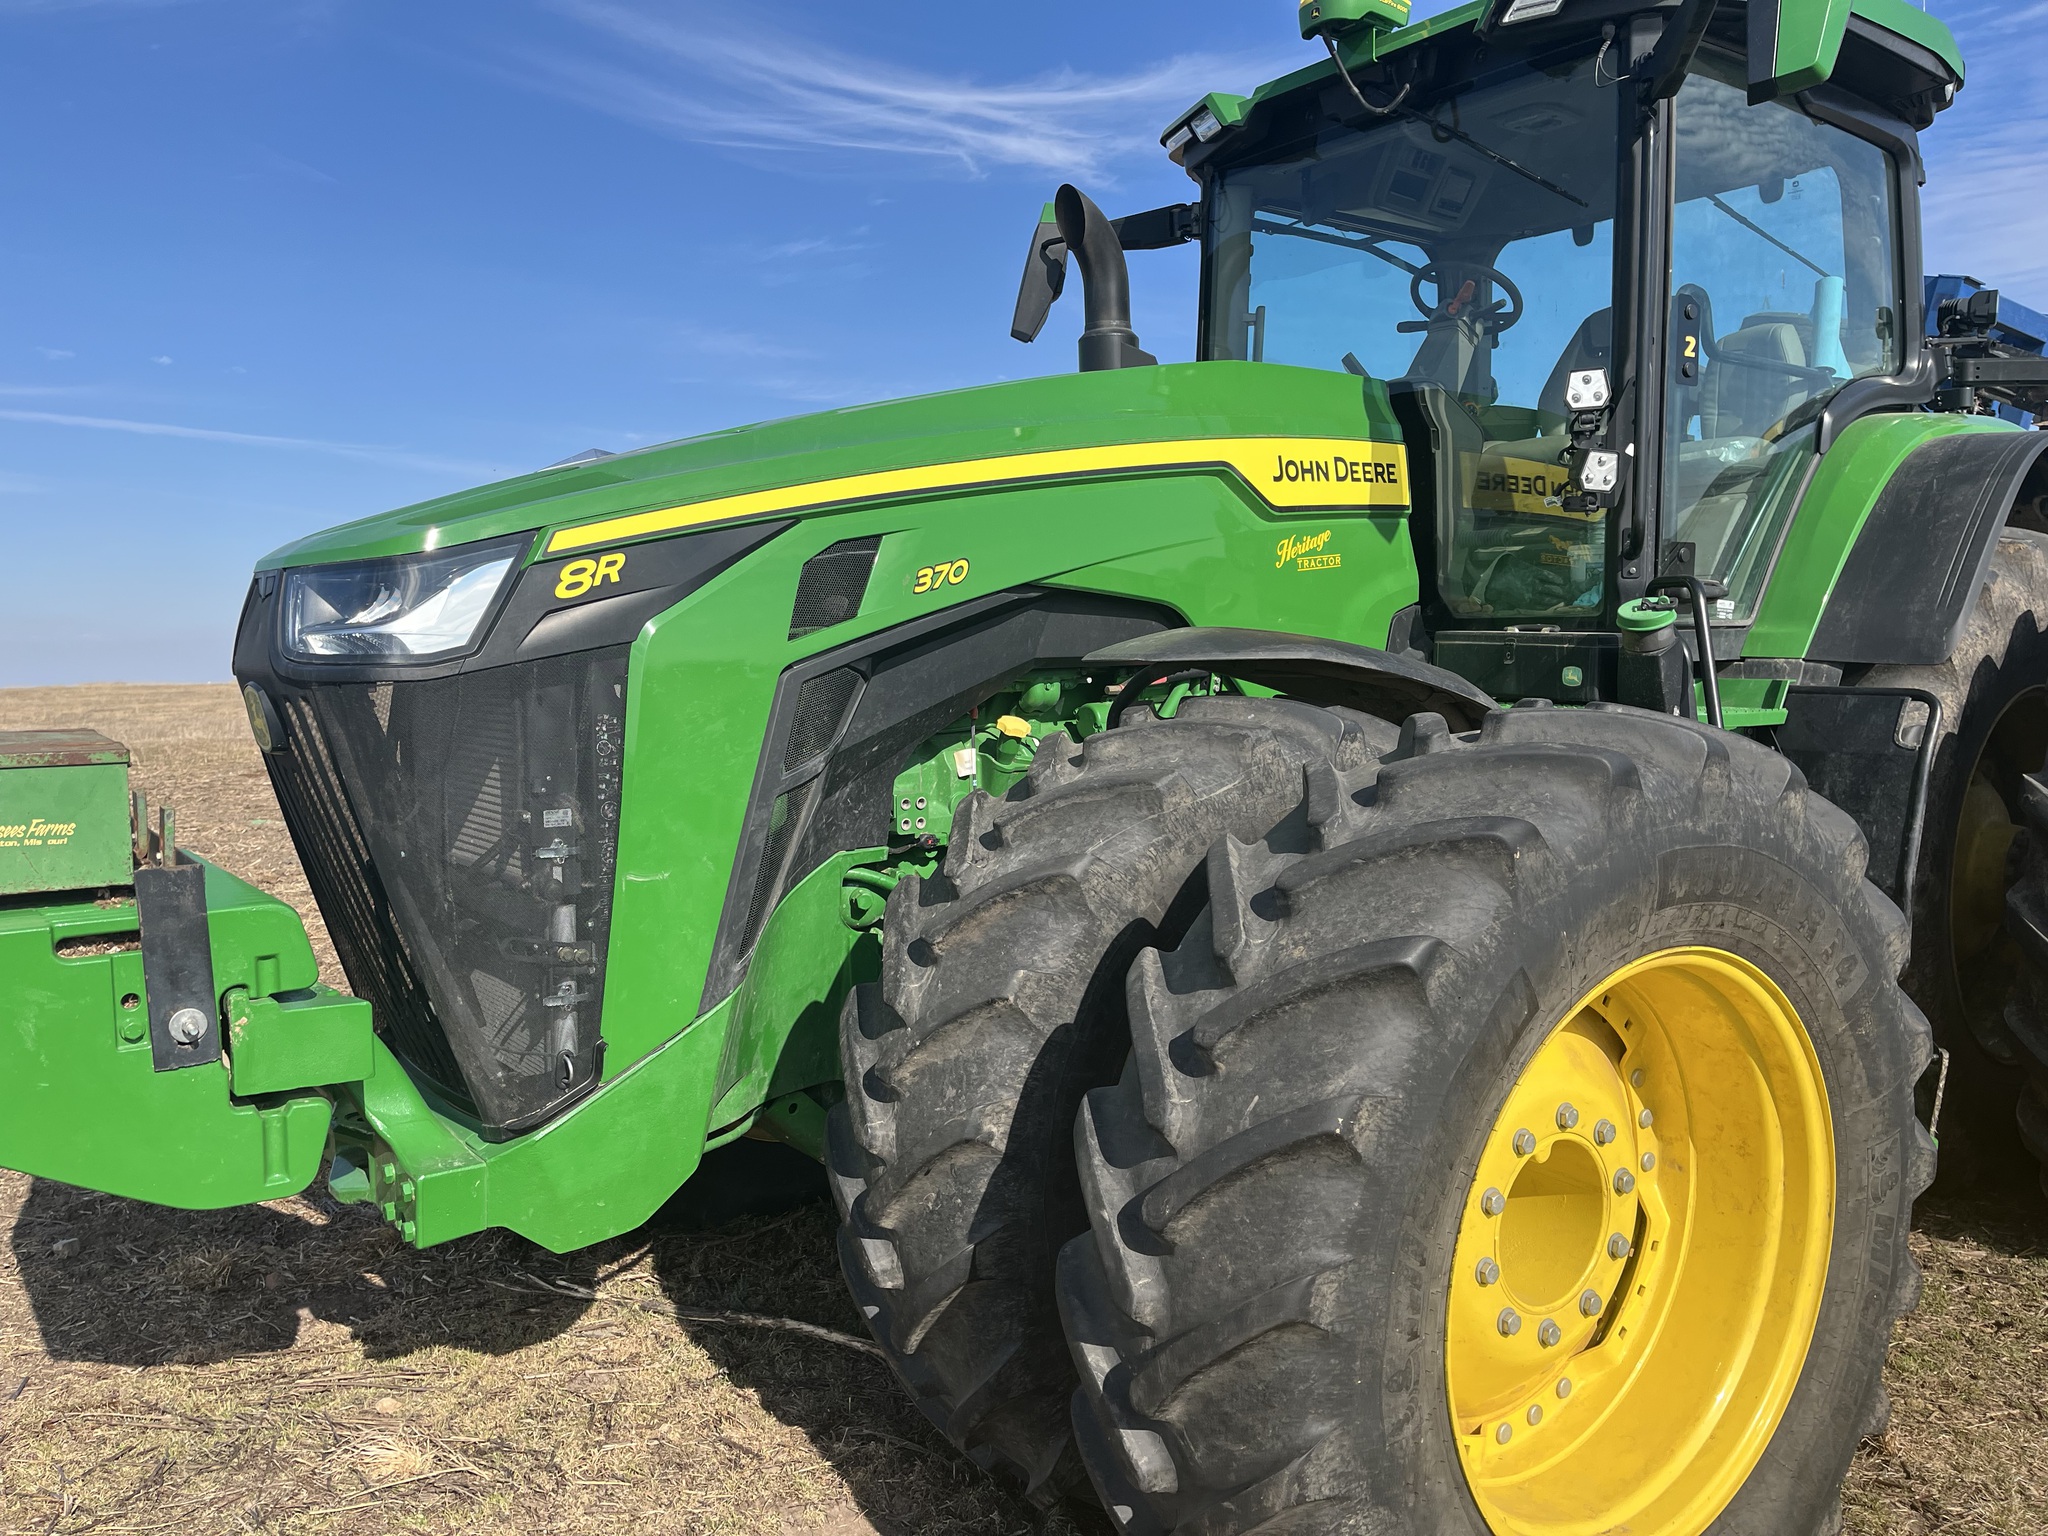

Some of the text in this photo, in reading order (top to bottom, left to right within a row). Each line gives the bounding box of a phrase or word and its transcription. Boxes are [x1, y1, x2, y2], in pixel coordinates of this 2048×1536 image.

[1684, 335, 1697, 358] 2
[1273, 455, 1398, 484] JOHN DEERE
[1276, 529, 1332, 569] Heritage
[1297, 556, 1341, 569] TRACTOR
[554, 552, 626, 599] 8R
[912, 557, 970, 595] 370
[26, 818, 77, 838] Farms
